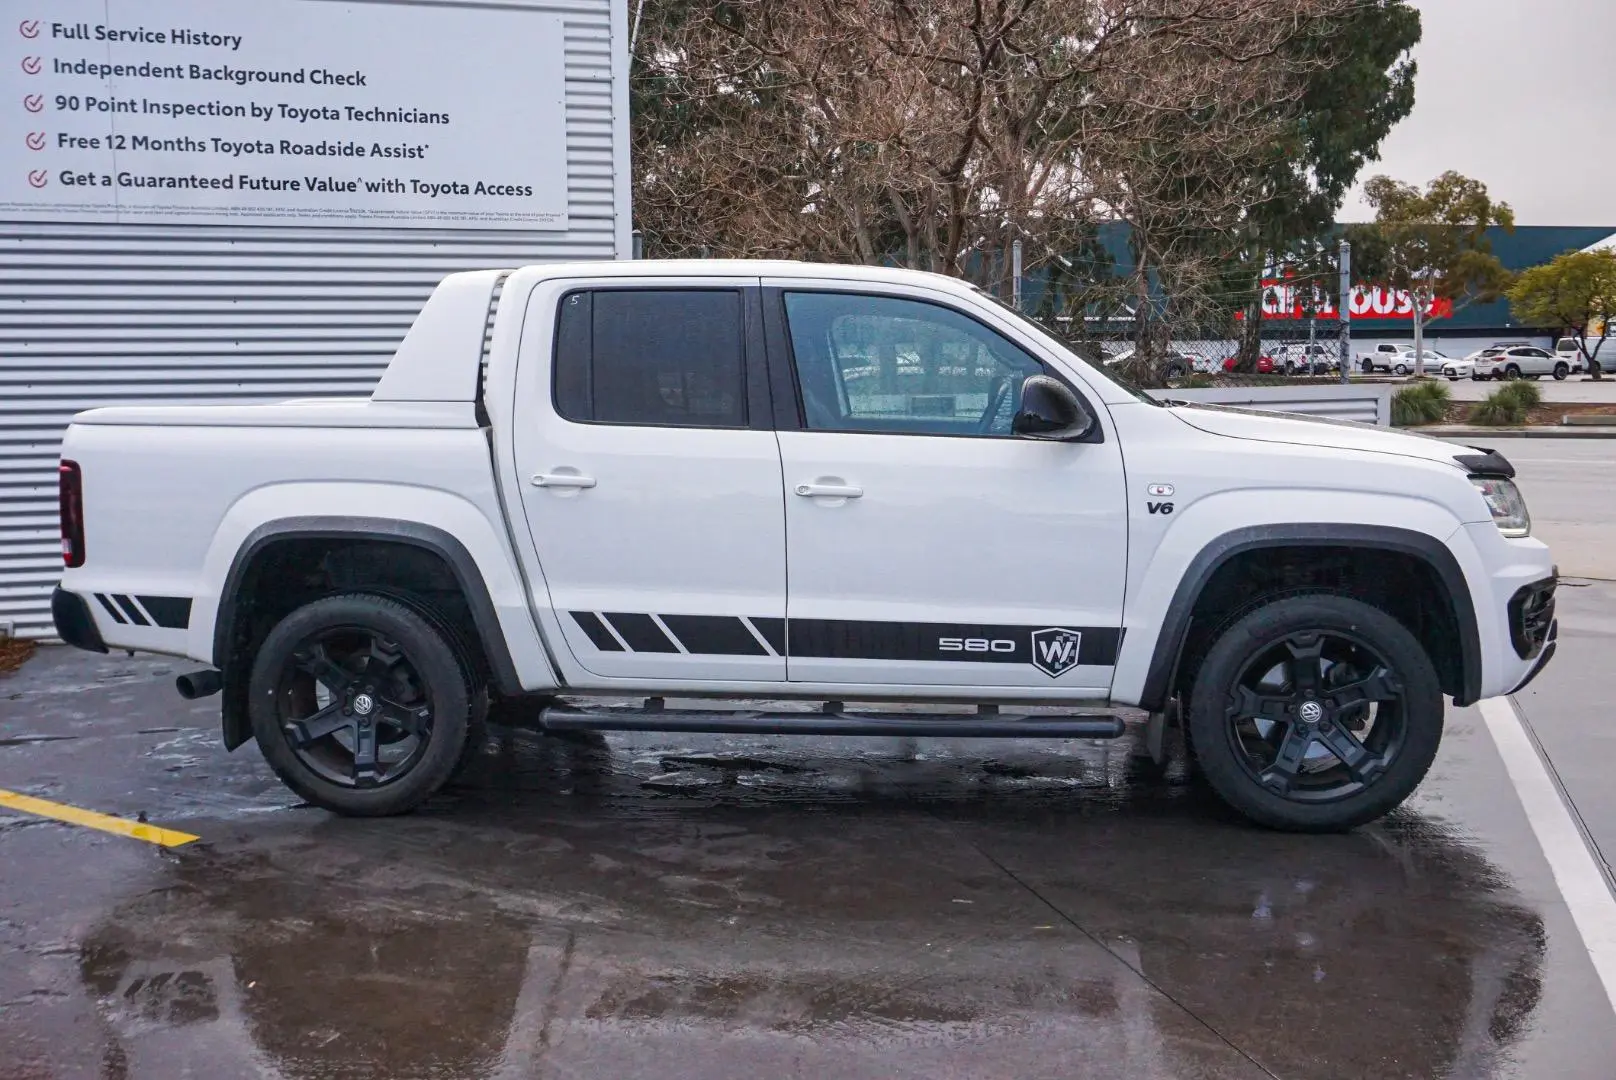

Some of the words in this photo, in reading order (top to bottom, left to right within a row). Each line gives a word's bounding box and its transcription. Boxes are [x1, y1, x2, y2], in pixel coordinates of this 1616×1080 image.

[51, 23, 90, 40] Full
[95, 25, 166, 43] Service
[171, 29, 242, 51] History
[54, 58, 184, 80] Independent
[189, 64, 304, 86] Background
[310, 69, 367, 87] Check
[55, 95, 80, 111] 90
[86, 97, 138, 114] Point
[143, 98, 245, 119] Inspection
[250, 102, 273, 122] by
[278, 104, 340, 123] Toyota
[344, 106, 450, 125] Technicians
[58, 133, 100, 149] Free
[105, 135, 126, 150] 12
[132, 135, 206, 153] Months
[211, 138, 274, 157] Toyota
[280, 140, 366, 157] Roadside
[59, 170, 97, 187] Get
[101, 176, 112, 187] a
[117, 172, 233, 190] Guaranteed
[239, 175, 300, 192] Future
[365, 178, 405, 194] with
[410, 179, 470, 198] Toyota
[474, 180, 533, 197] Access
[1147, 501, 1174, 515] V6
[938, 637, 1015, 653] 580
